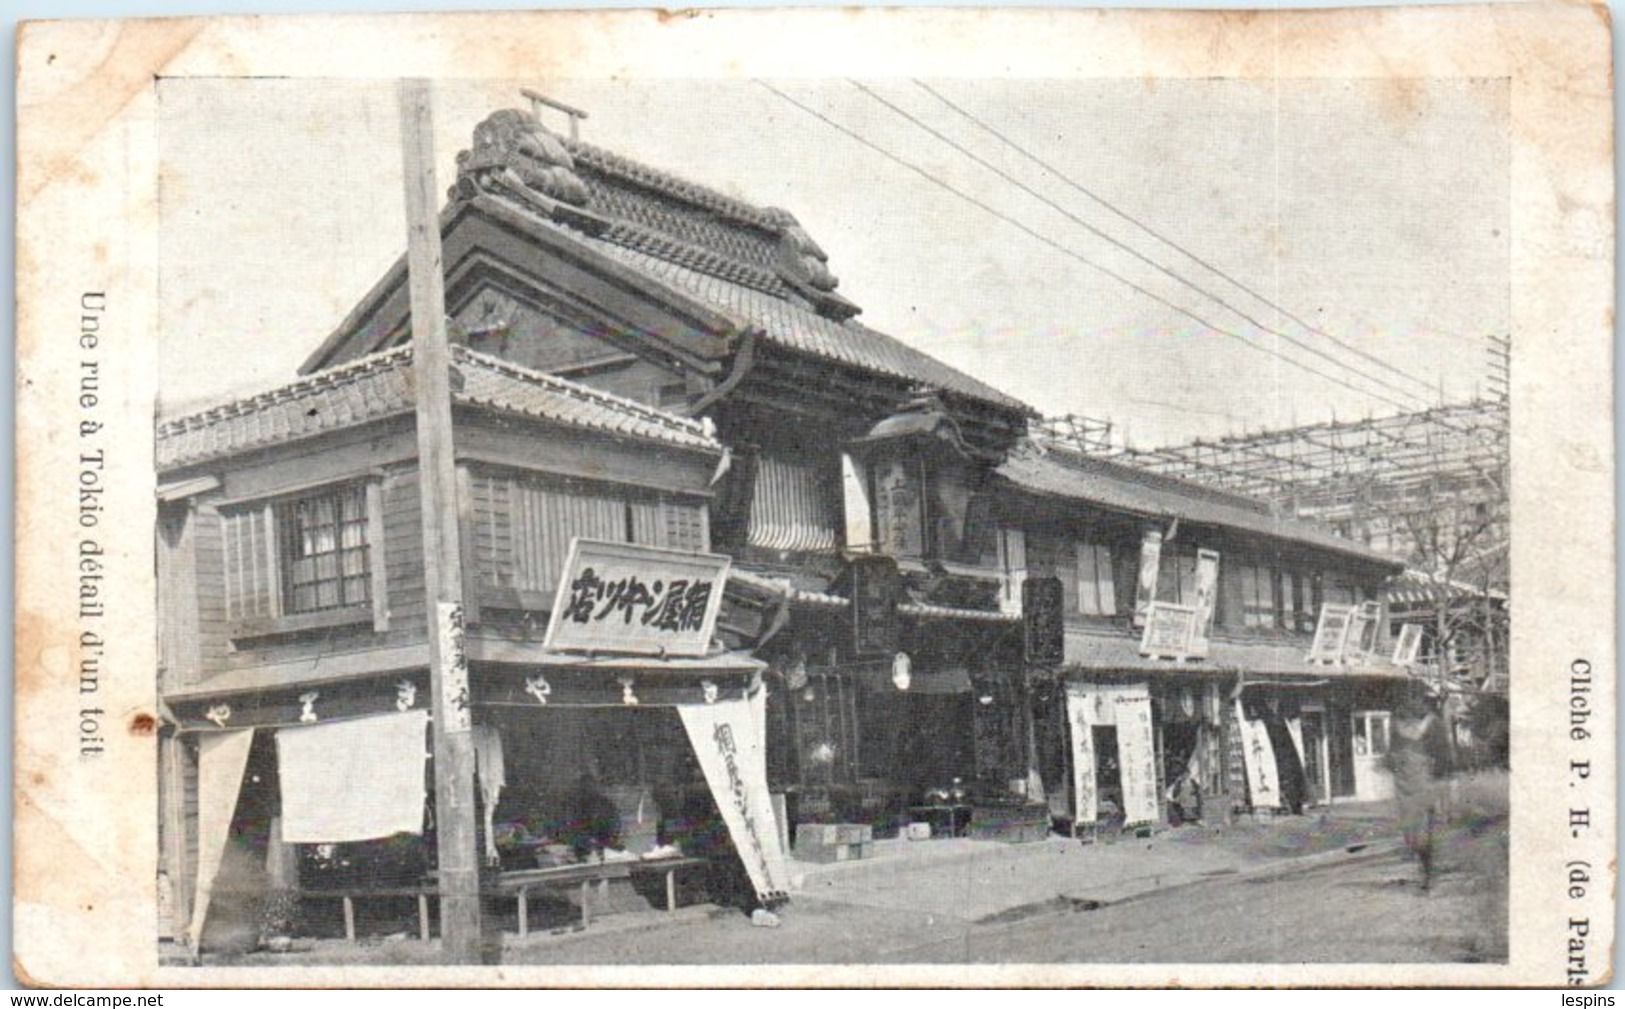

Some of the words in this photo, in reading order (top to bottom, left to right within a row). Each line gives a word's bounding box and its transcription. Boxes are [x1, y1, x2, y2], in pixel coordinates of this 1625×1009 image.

[80, 291, 105, 349] Une
[79, 361, 98, 408] rue
[79, 420, 104, 437] à
[79, 449, 104, 527] Tokio
[79, 540, 104, 618] détail
[79, 631, 104, 694] d'un
[1570, 657, 1592, 740] Cliché
[79, 708, 104, 755] toit
[1569, 760, 1591, 787] P.
[1566, 861, 1591, 899] (de
